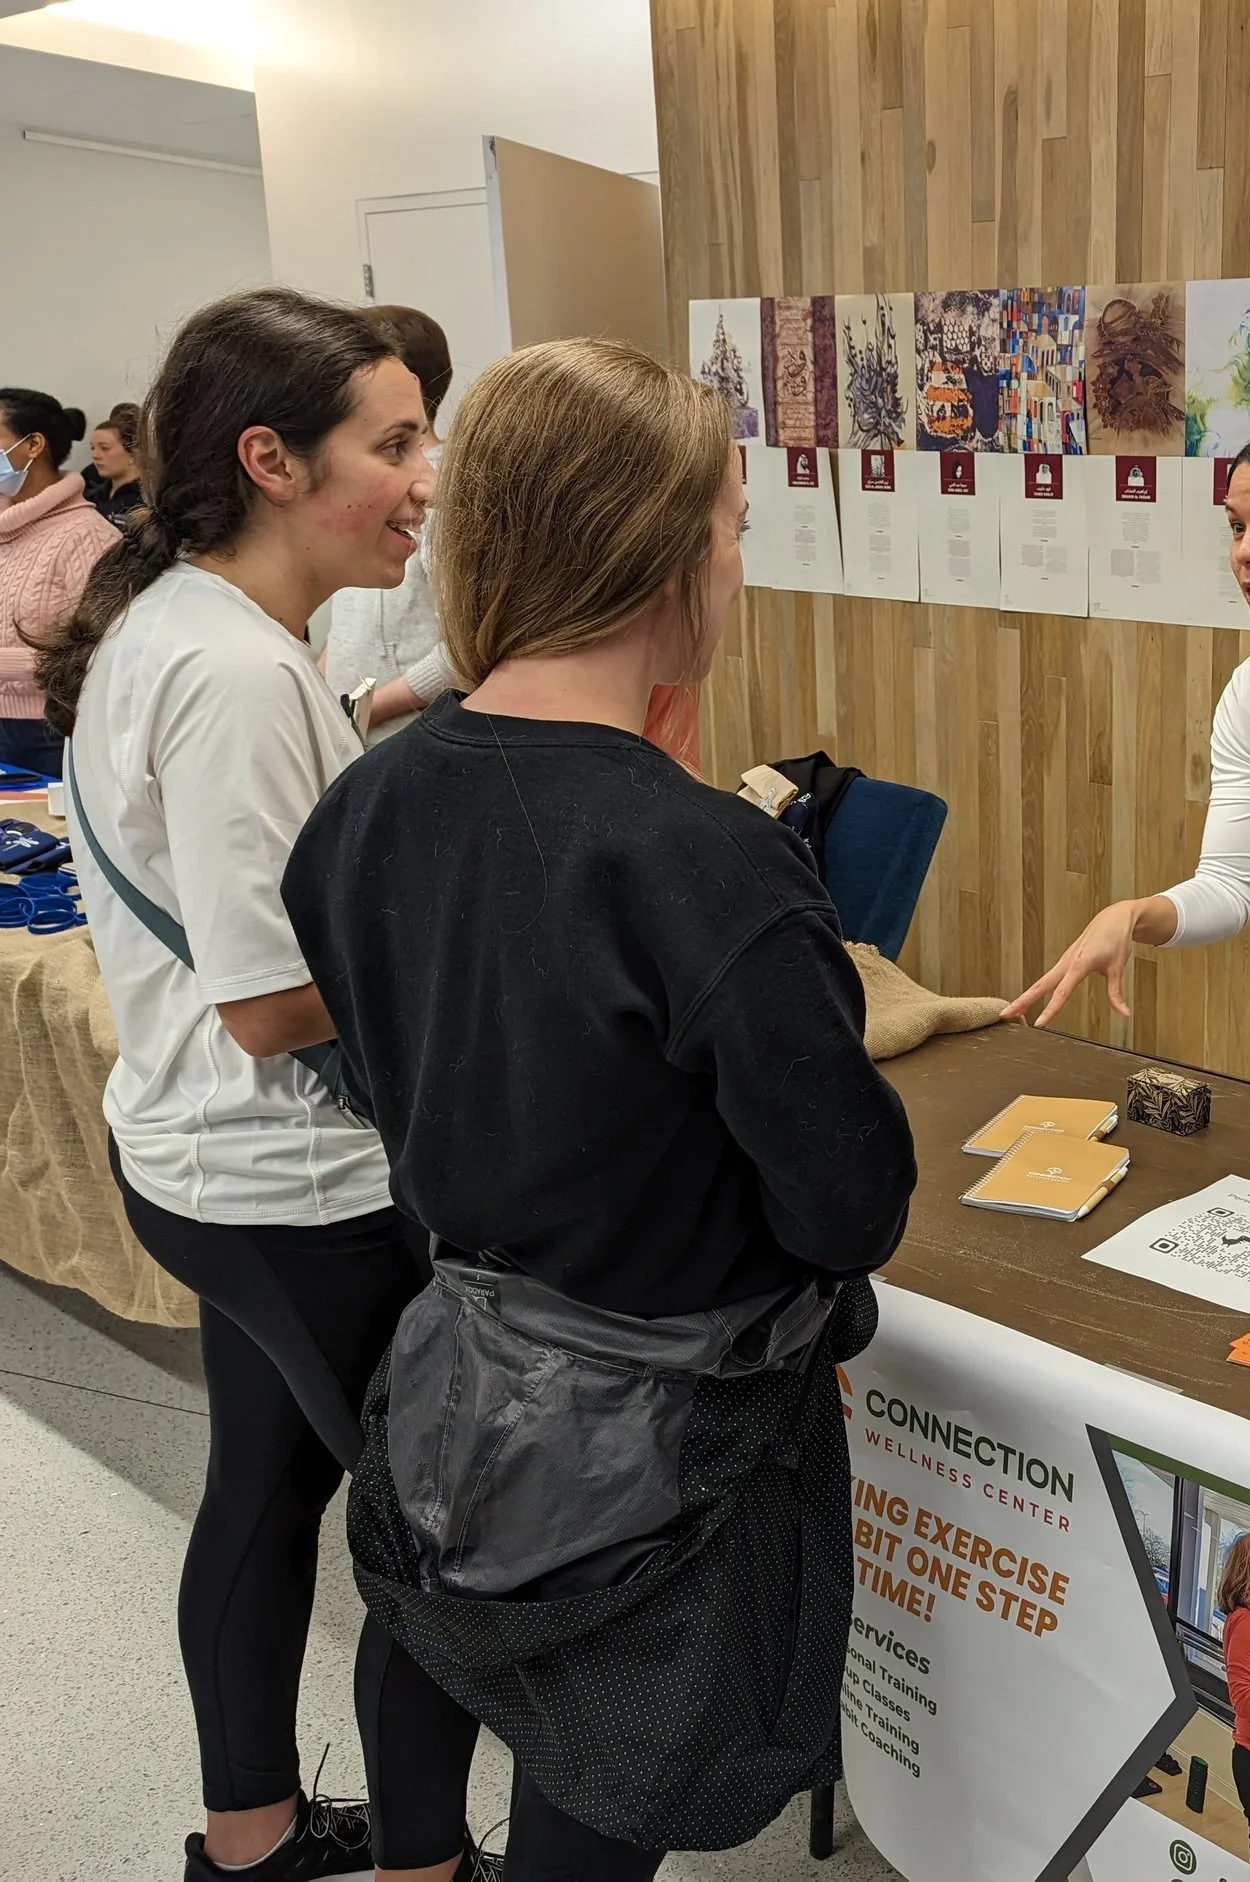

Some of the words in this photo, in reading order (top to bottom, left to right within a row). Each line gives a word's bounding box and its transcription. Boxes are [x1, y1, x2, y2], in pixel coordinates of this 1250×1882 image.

[866, 1389, 1074, 1503] CONNECTION
[865, 1428, 972, 1489] WELLNESS
[983, 1483, 1071, 1533] CENTER
[851, 1475, 909, 1526] ING
[913, 1507, 1071, 1606] EXERCISE
[857, 1555, 937, 1623] TIME!
[906, 1545, 972, 1601] ONE
[975, 1580, 1059, 1638] STEP
[852, 1615, 931, 1675] ervices
[862, 1678, 911, 1722] Classes
[879, 1665, 938, 1716] Training
[861, 1721, 921, 1778] Coaching
[865, 1703, 920, 1756] Training
